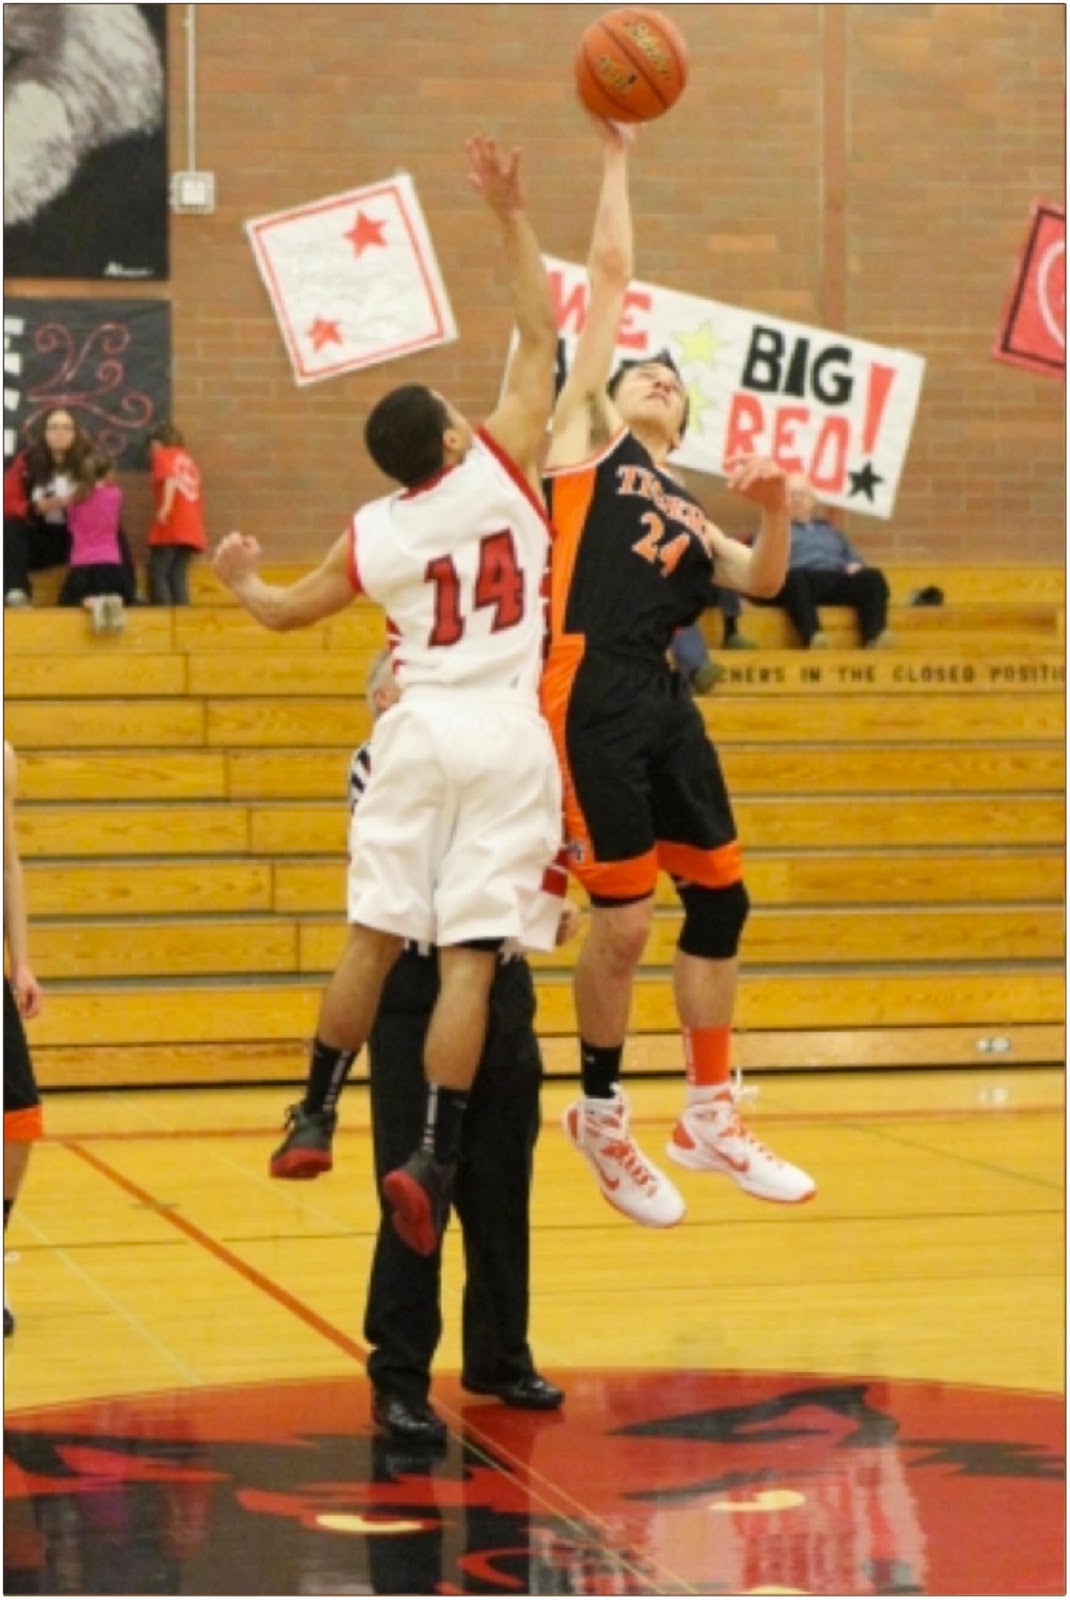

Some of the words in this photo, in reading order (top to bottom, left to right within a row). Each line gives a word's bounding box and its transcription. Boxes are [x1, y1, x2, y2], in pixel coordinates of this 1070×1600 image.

[742, 324, 853, 405] BIG
[632, 511, 690, 578] 24
[424, 528, 525, 649] 14
[801, 665, 821, 684] IN
[837, 665, 876, 684] THE
[893, 664, 975, 684] CLOSED
